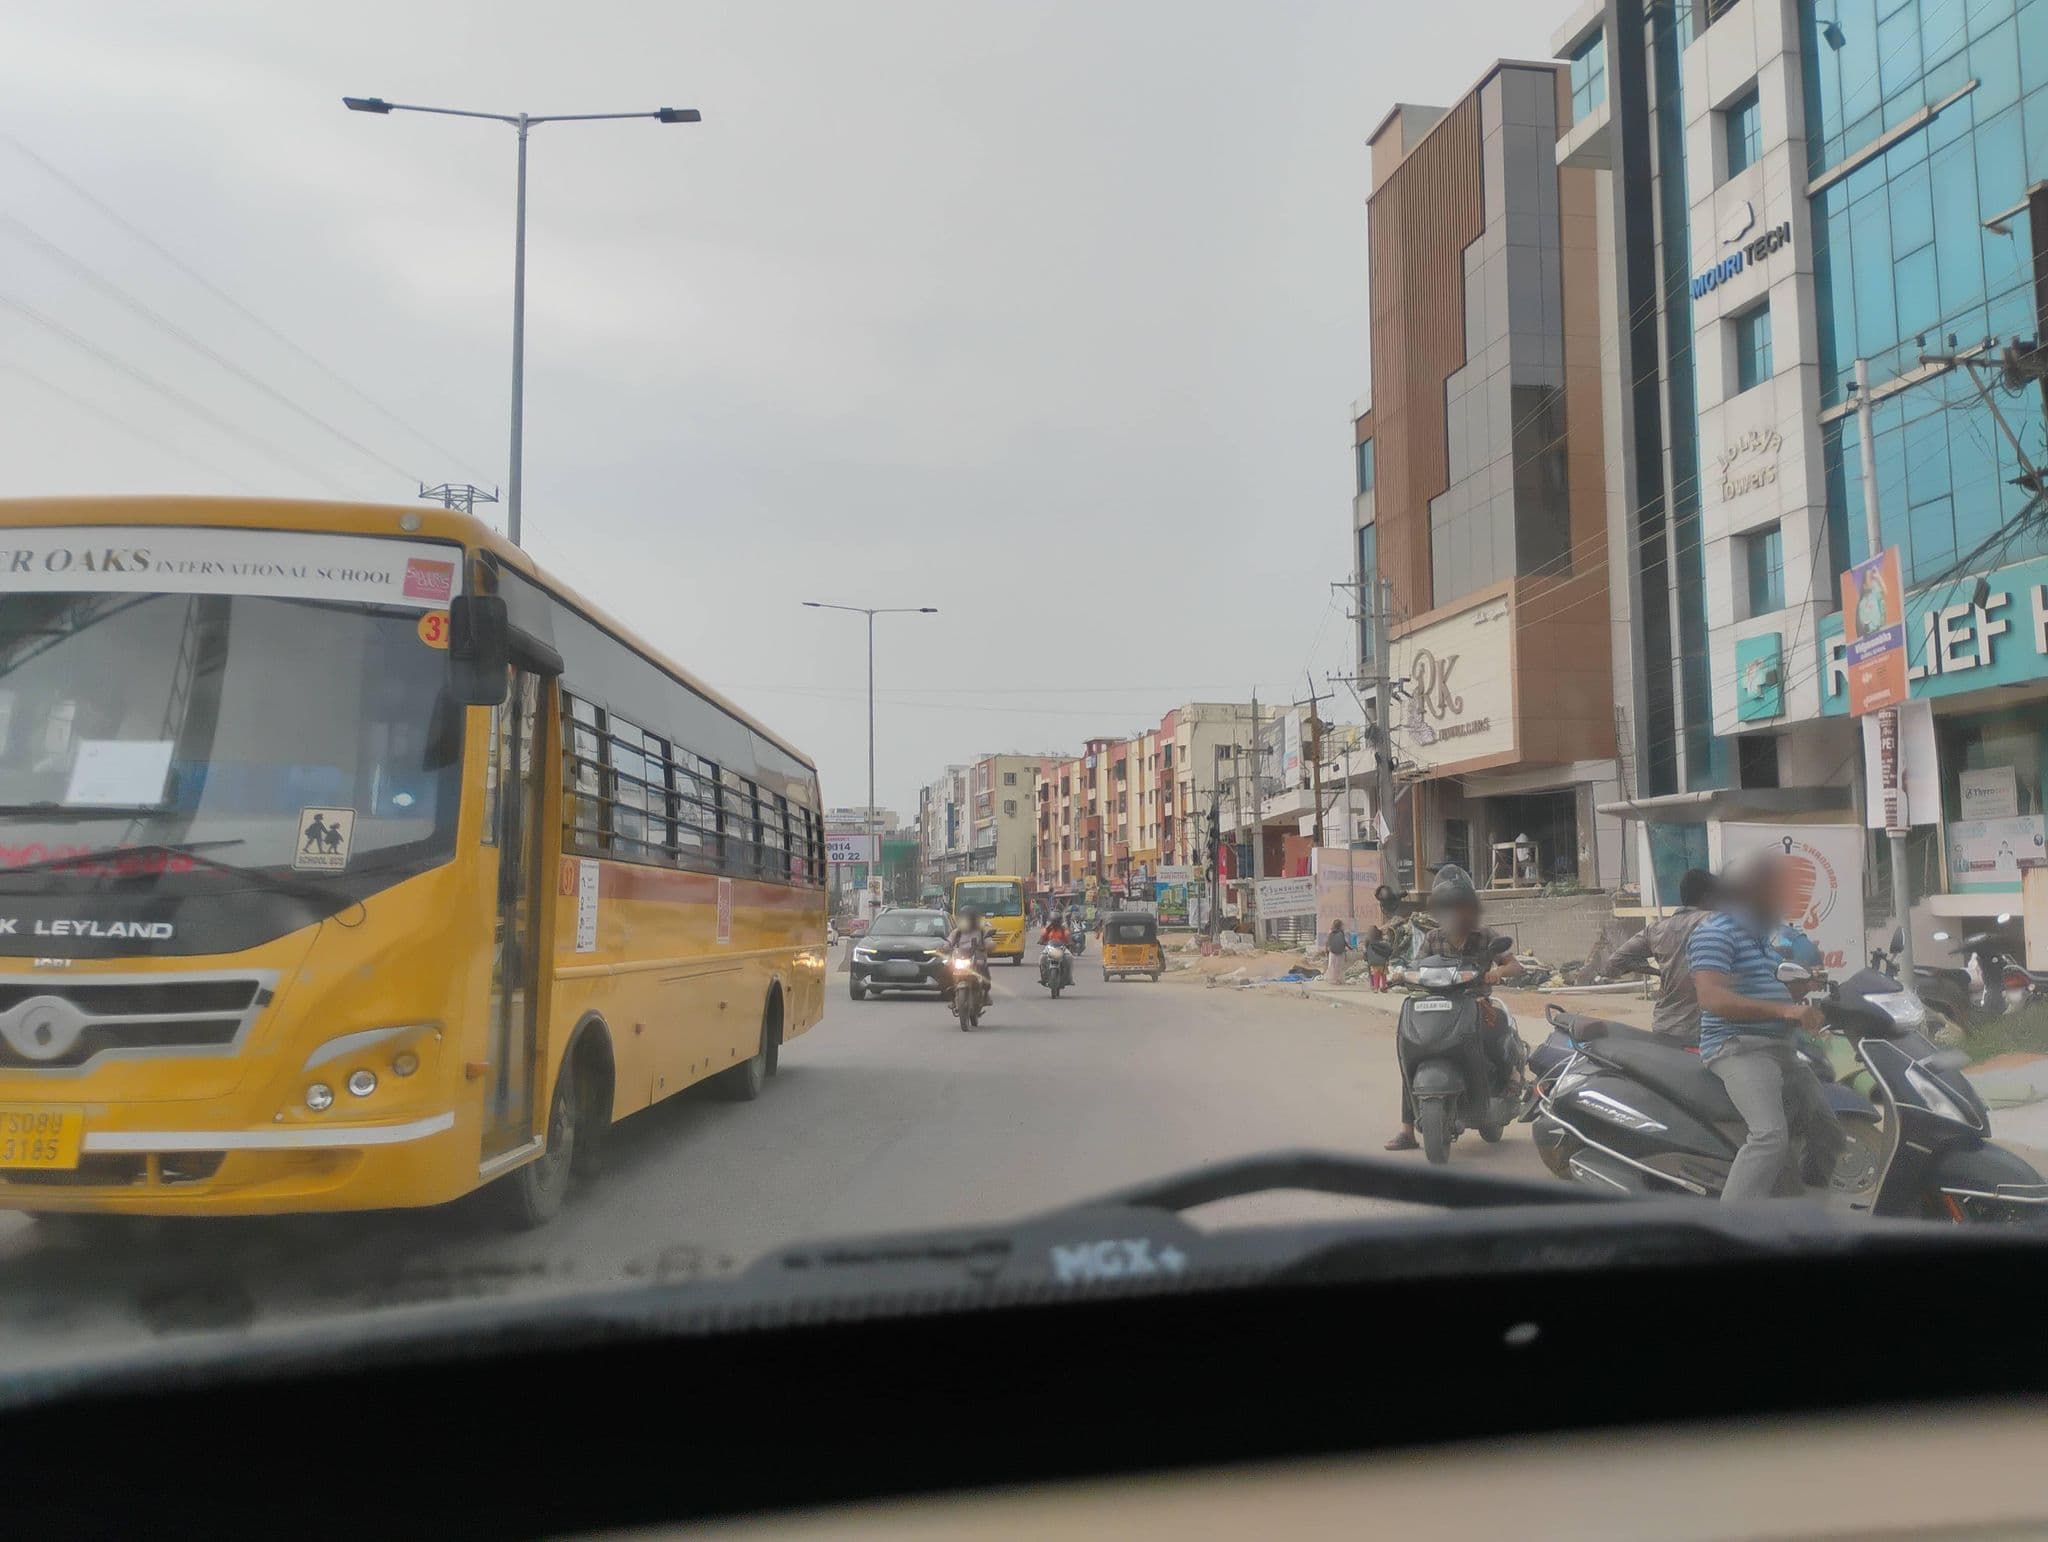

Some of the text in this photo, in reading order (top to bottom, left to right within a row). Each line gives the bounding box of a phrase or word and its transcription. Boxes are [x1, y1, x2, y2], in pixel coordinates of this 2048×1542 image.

[1691, 221, 1791, 300] MOURI TECH
[45, 548, 151, 573] OAKS
[156, 561, 307, 577] INTERNATIONAL
[315, 567, 393, 585] SCHOOL
[1825, 591, 2008, 697] RIEF
[1411, 647, 1464, 720] RK
[34, 919, 173, 938] LEYLAND
